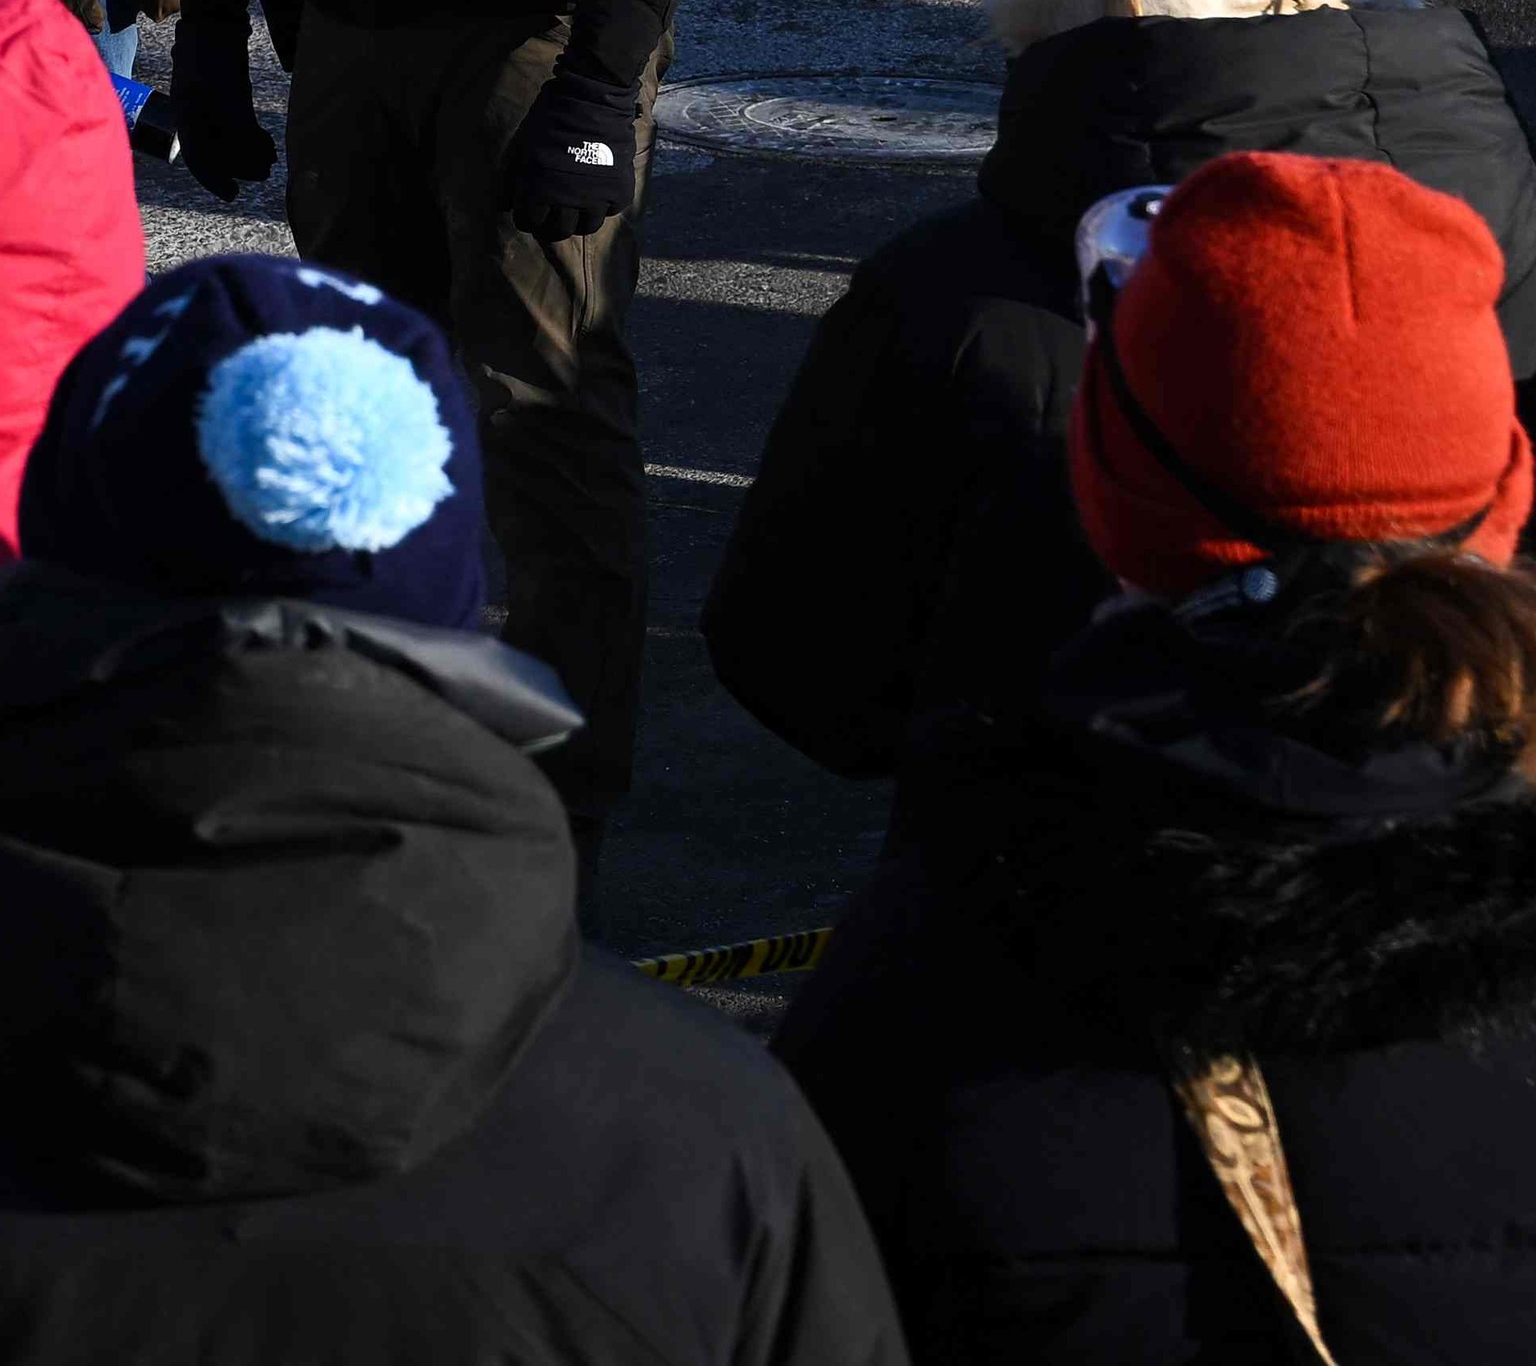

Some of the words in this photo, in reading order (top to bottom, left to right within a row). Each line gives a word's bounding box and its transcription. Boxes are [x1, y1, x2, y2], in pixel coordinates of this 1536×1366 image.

[583, 141, 600, 151] THE
[567, 146, 600, 159] NORTH
[575, 155, 600, 166] FACE
